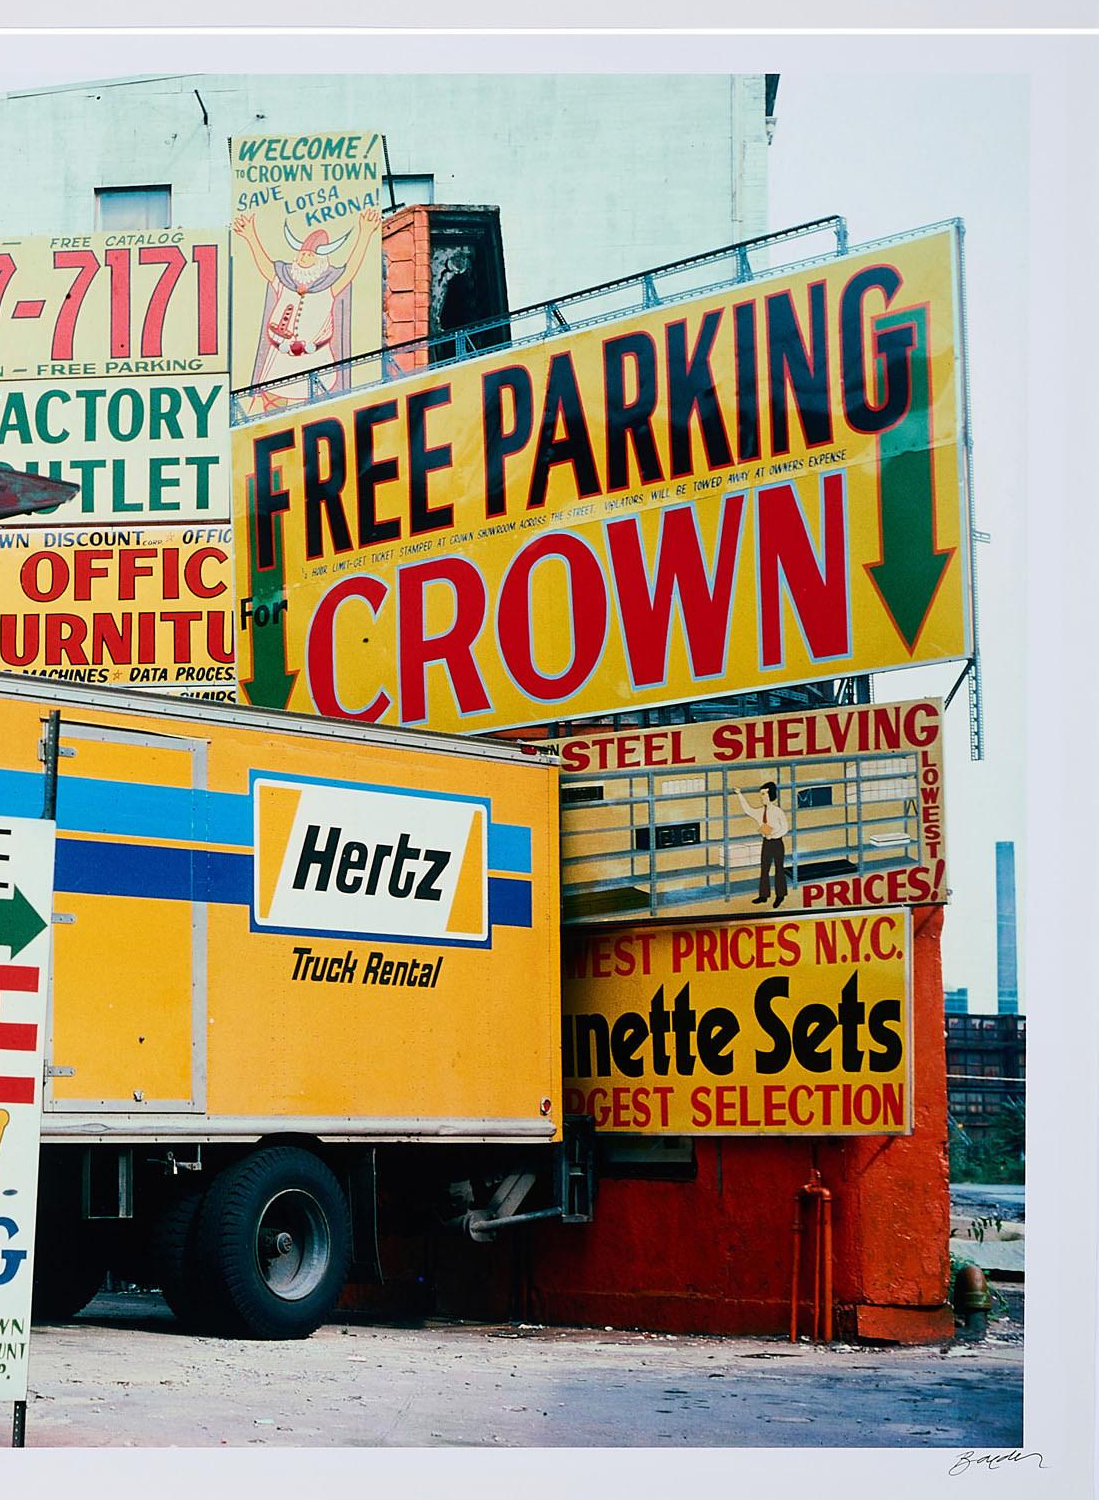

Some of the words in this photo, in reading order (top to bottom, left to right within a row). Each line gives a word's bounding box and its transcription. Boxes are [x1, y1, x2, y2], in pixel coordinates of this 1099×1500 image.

[247, 165, 313, 183] CROWN
[321, 162, 377, 181] TOWN
[237, 185, 283, 212] SAVE
[284, 185, 339, 214] LOTSA
[305, 188, 380, 227] KRONA!
[50, 237, 92, 249] FREE
[105, 232, 185, 247] CATALOG
[37, 362, 96, 376] FREE
[106, 358, 203, 374] PARKING
[252, 382, 456, 571] FREE
[482, 263, 918, 520] PARKING
[400, 540, 433, 557] STAMPED
[437, 536, 446, 547] AT
[449, 531, 475, 544] CROWN
[519, 515, 547, 528] ACROSS
[551, 512, 563, 521] THE
[651, 488, 670, 501] WILL
[676, 484, 687, 495] BE
[693, 475, 722, 491] TOWED
[727, 469, 749, 484] AWAY
[754, 466, 766, 478] AT
[769, 458, 804, 474] OWNERS
[808, 449, 847, 467] EXPENSE
[44, 530, 145, 548] DISCOUNT
[20, 546, 228, 602] OFFIC
[240, 597, 288, 631] For
[305, 471, 853, 725] CROWN
[129, 667, 168, 683] DATA
[562, 730, 696, 772] STEEL
[713, 703, 940, 761] SHELVING
[920, 750, 941, 859] LOWEST
[292, 824, 452, 901] Hertz
[803, 858, 946, 908] PRICES!
[292, 947, 358, 984] Truck
[362, 951, 444, 988] Rental
[672, 923, 801, 973] PRICES
[816, 916, 903, 964] N.Y.C.
[754, 970, 903, 1074] Sets
[691, 1083, 903, 1127] SELECTION
